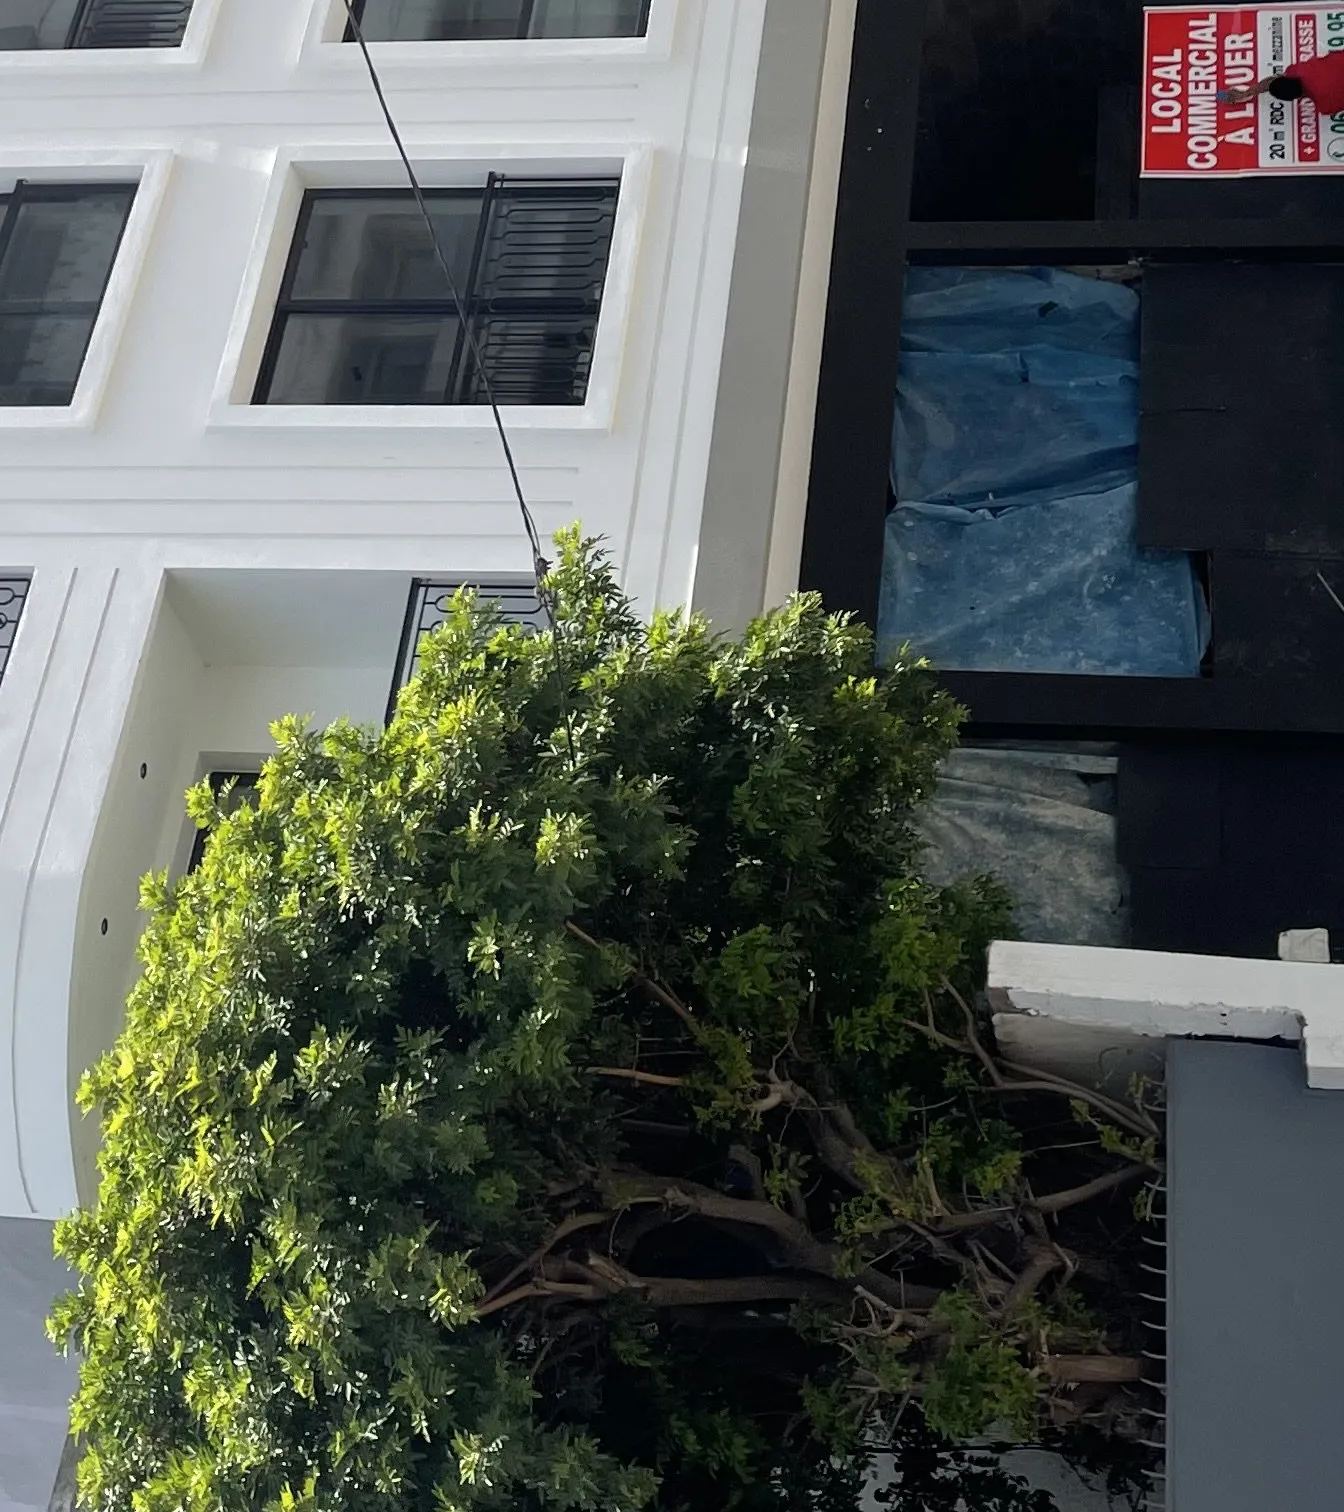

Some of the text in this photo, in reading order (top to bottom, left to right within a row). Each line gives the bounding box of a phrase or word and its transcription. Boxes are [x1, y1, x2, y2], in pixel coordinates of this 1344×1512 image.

[1150, 48, 1182, 133] LOCAL
[1186, 13, 1218, 169] COMMERCIAL
[1270, 101, 1285, 126] RDC
[1300, 97, 1316, 144] GRAND
[1217, 126, 1255, 145] À
[1269, 144, 1285, 160] 20
